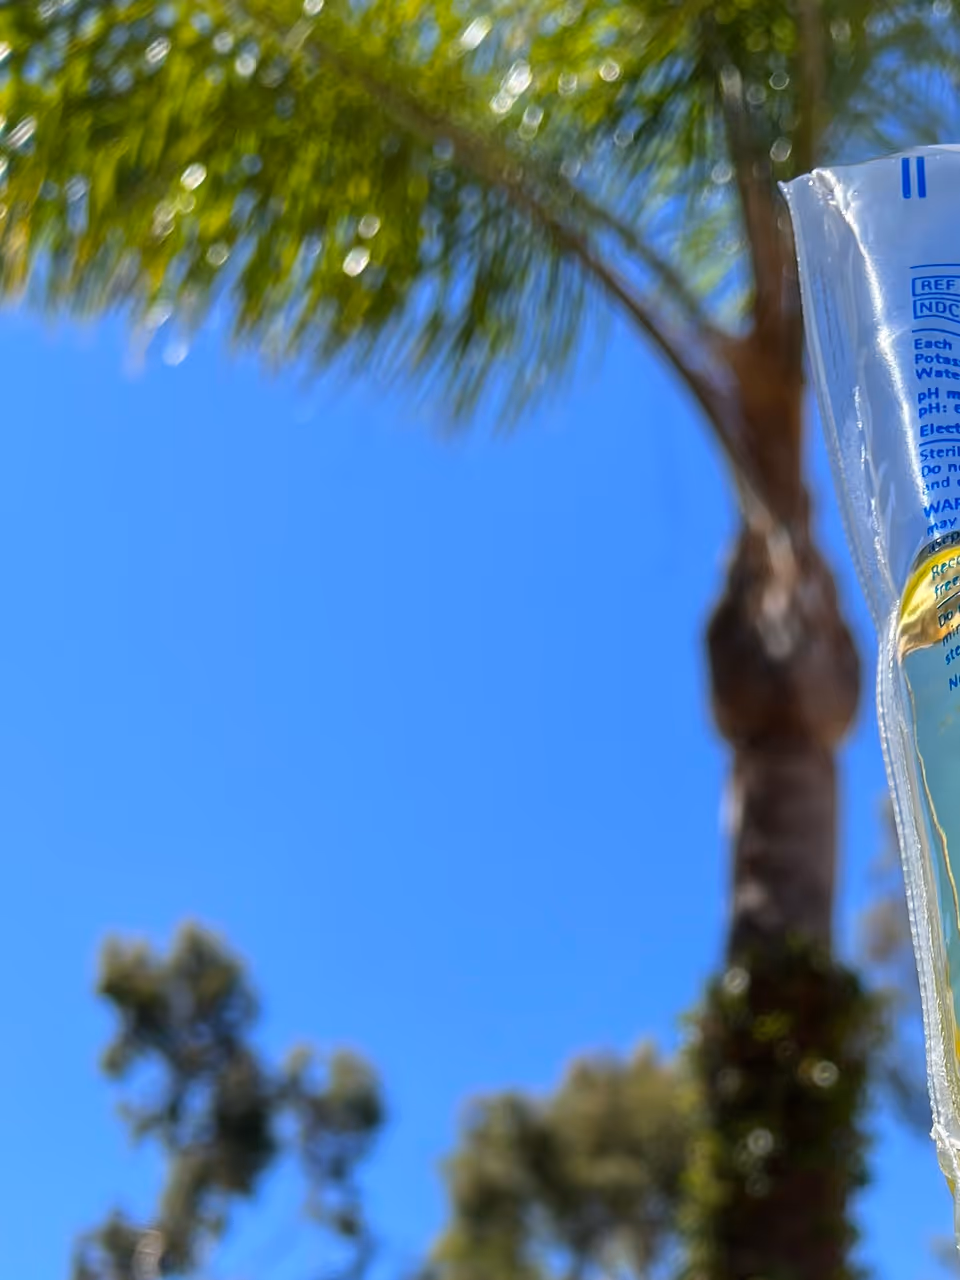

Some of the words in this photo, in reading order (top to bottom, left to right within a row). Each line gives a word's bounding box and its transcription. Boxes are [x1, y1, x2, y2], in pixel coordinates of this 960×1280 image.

[921, 279, 955, 292] REF
[919, 301, 960, 318] NDC
[914, 337, 952, 350] Each
[917, 386, 939, 404] pH
[926, 516, 957, 537] may
[938, 610, 954, 628] Do
